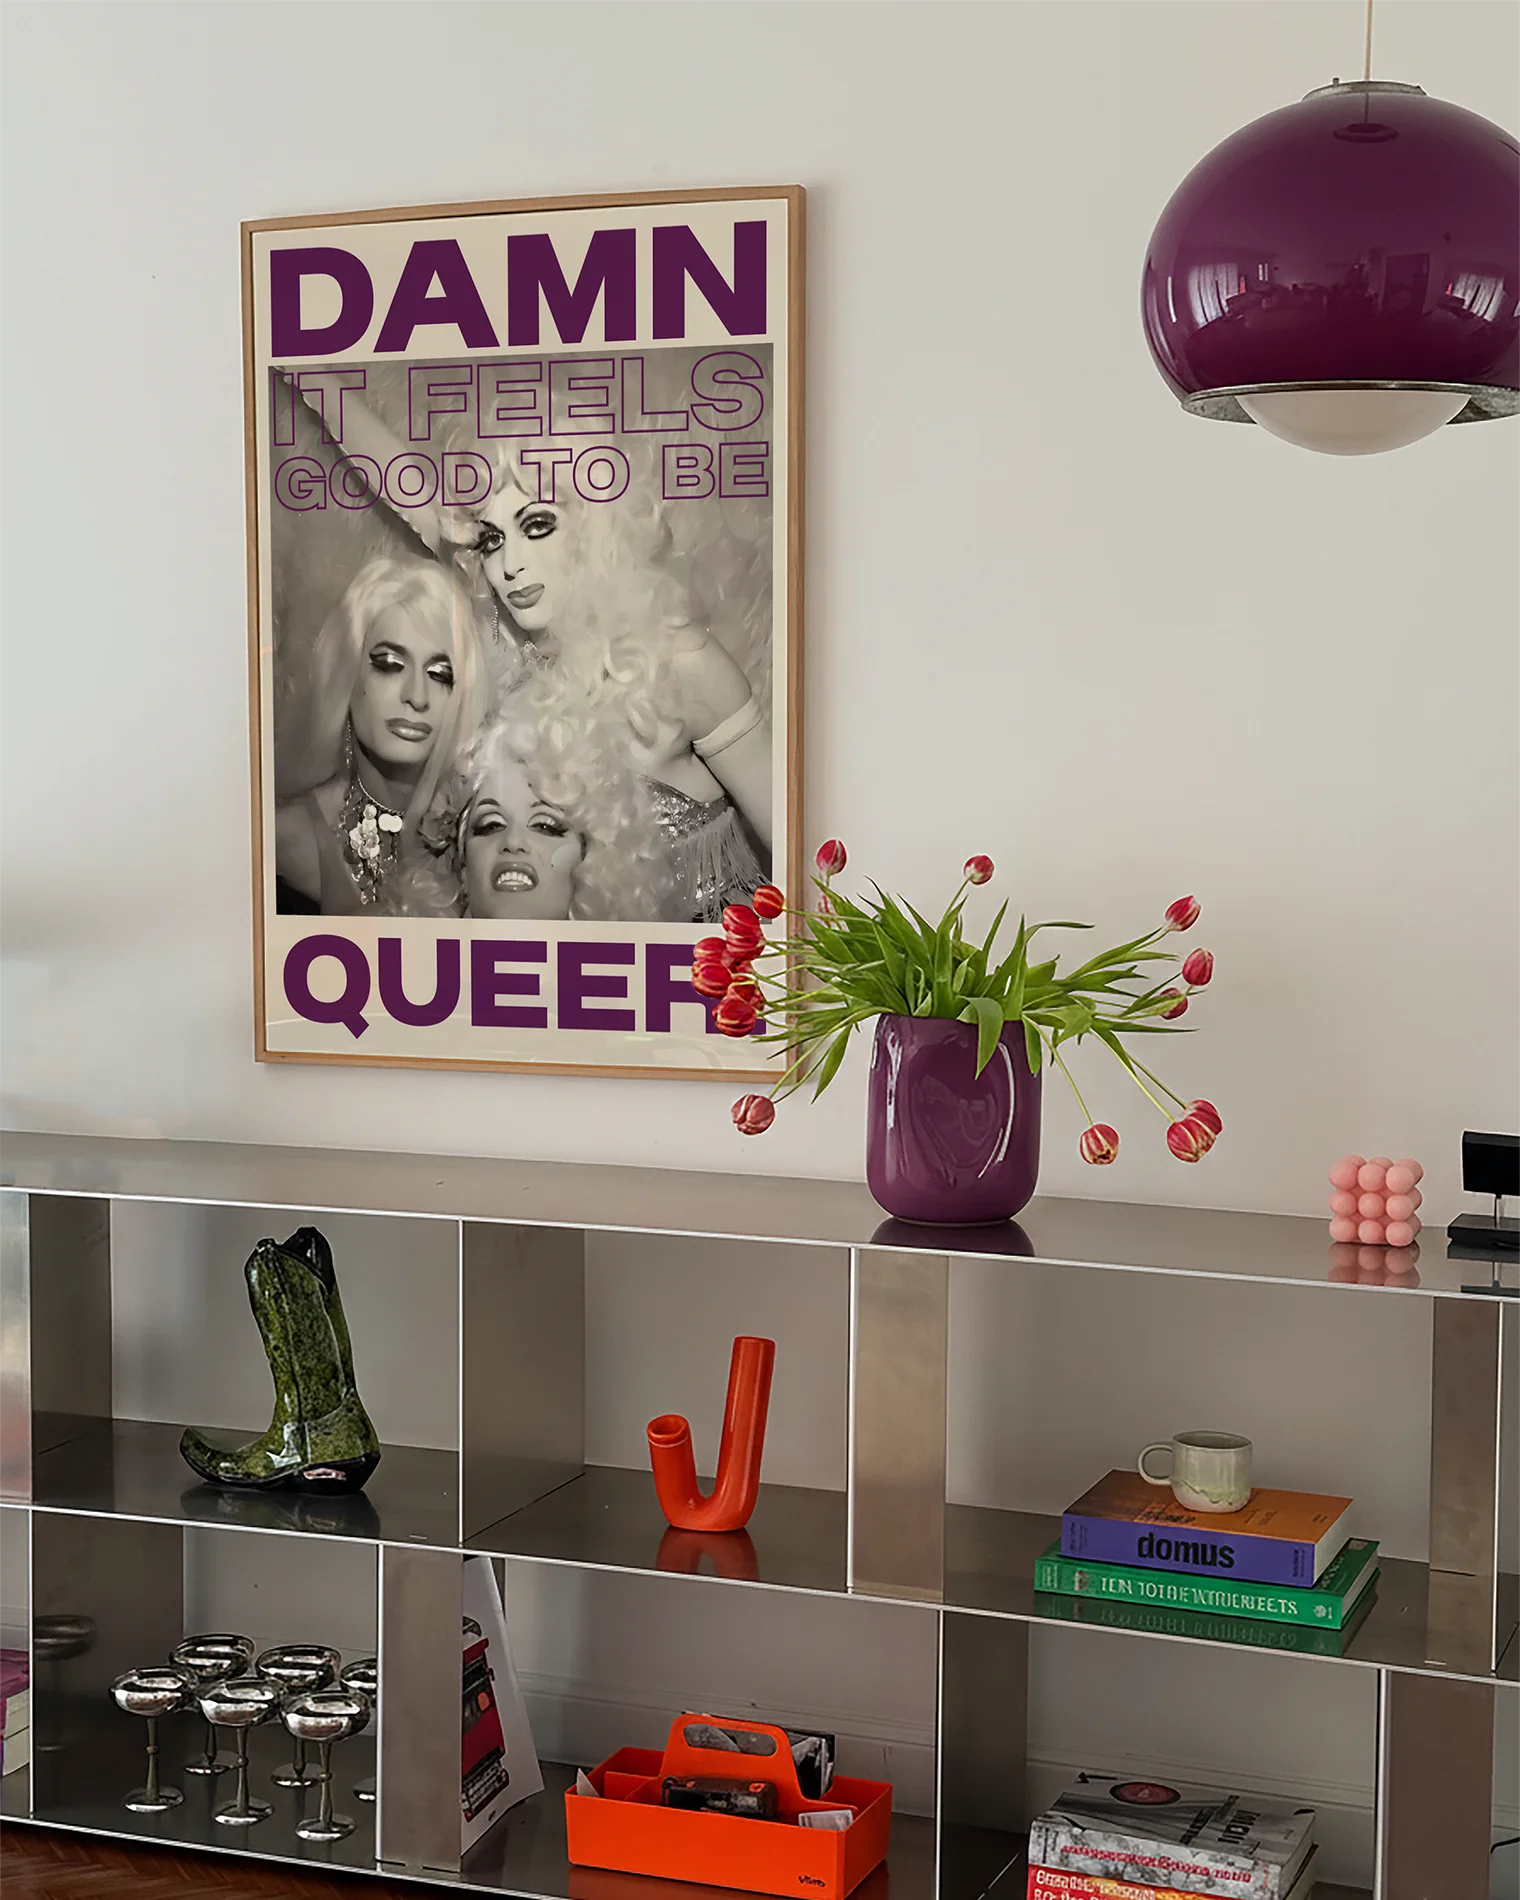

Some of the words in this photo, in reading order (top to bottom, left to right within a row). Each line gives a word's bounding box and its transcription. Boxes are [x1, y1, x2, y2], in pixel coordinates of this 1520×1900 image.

[269, 220, 767, 358] DAMN
[272, 369, 367, 446] IT
[408, 351, 765, 442] FEELS
[274, 452, 493, 512] GOOD
[520, 446, 631, 504] TO
[661, 441, 769, 501] BE
[1137, 1531, 1235, 1569] domus
